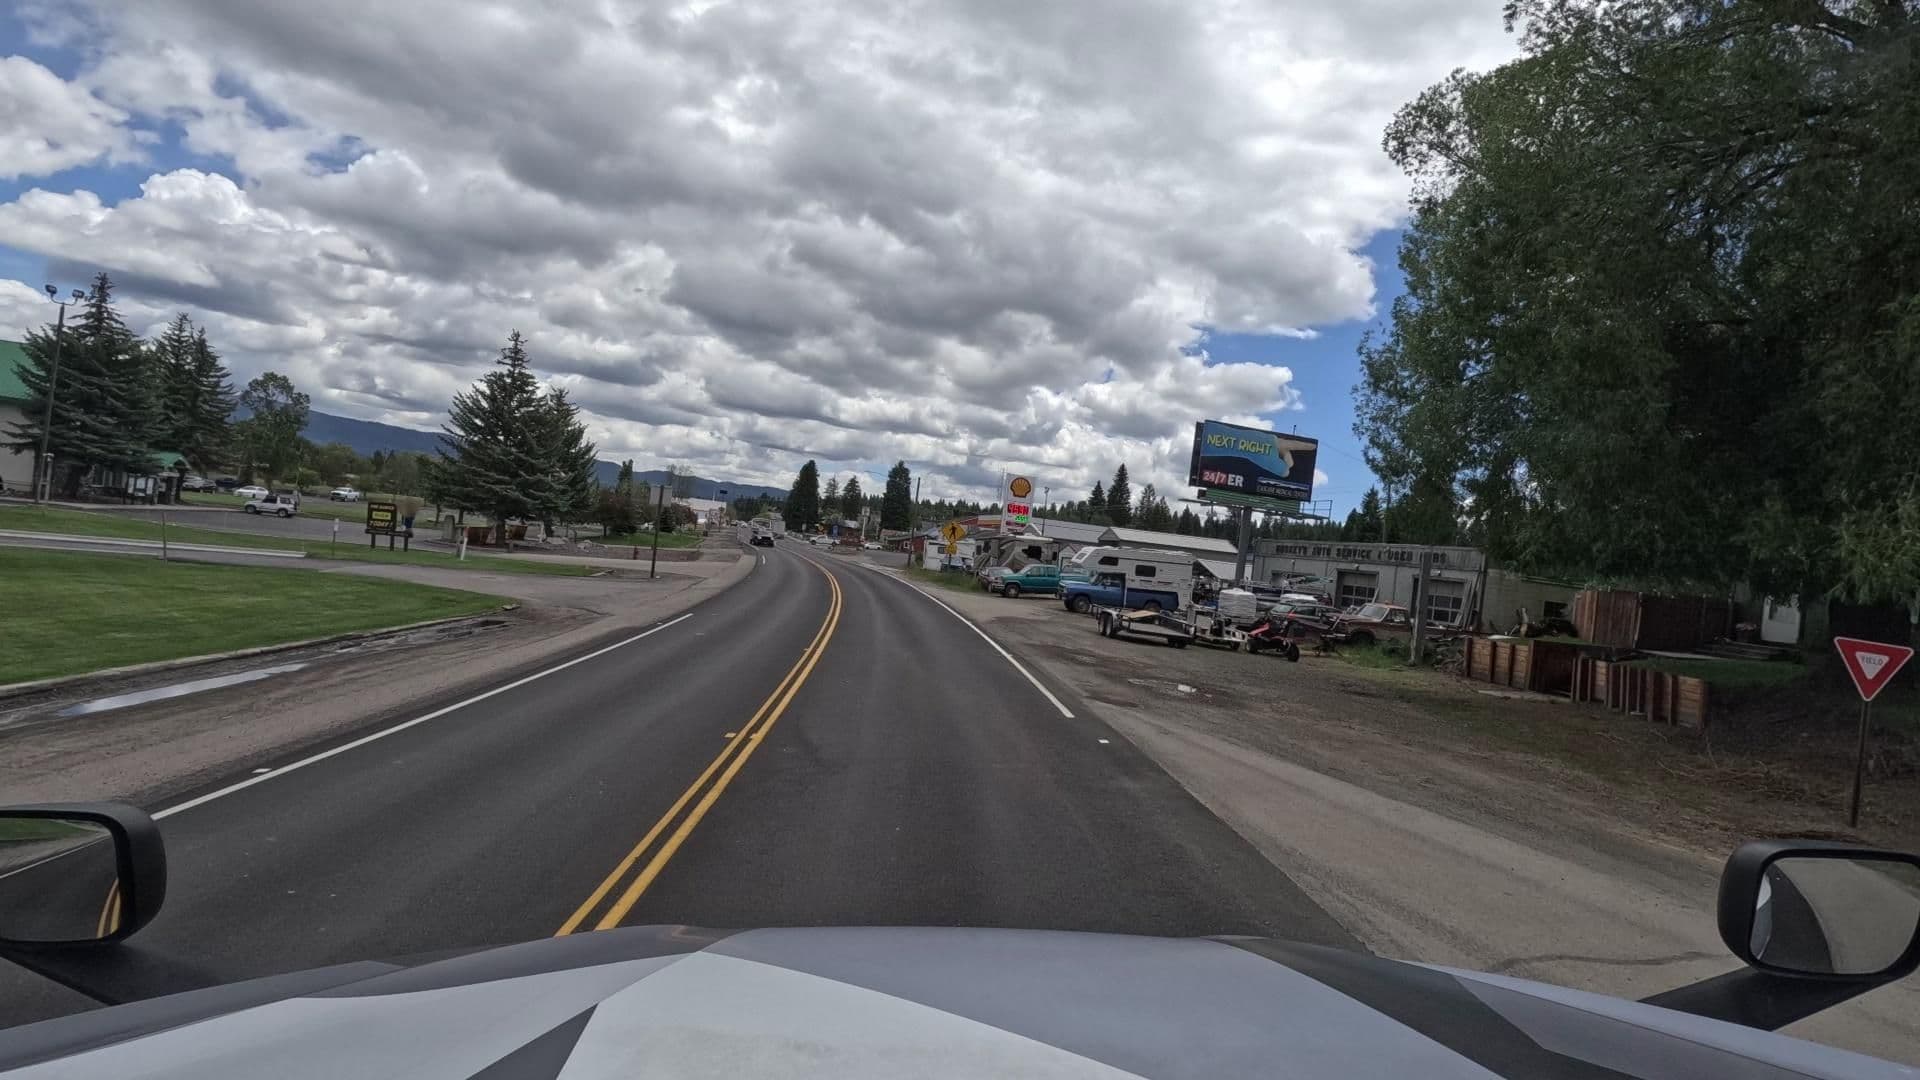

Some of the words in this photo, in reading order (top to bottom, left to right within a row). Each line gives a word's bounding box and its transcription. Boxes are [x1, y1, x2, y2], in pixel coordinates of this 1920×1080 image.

[1207, 434, 1236, 449] NEXT
[1238, 439, 1272, 456] RIGHT
[1202, 471, 1227, 485] 24/7
[1227, 474, 1244, 488] ER
[1312, 546, 1331, 556] AUTO
[1336, 547, 1373, 560] SERVICE
[1387, 550, 1413, 561] USED
[1861, 655, 1883, 665] YIELD
